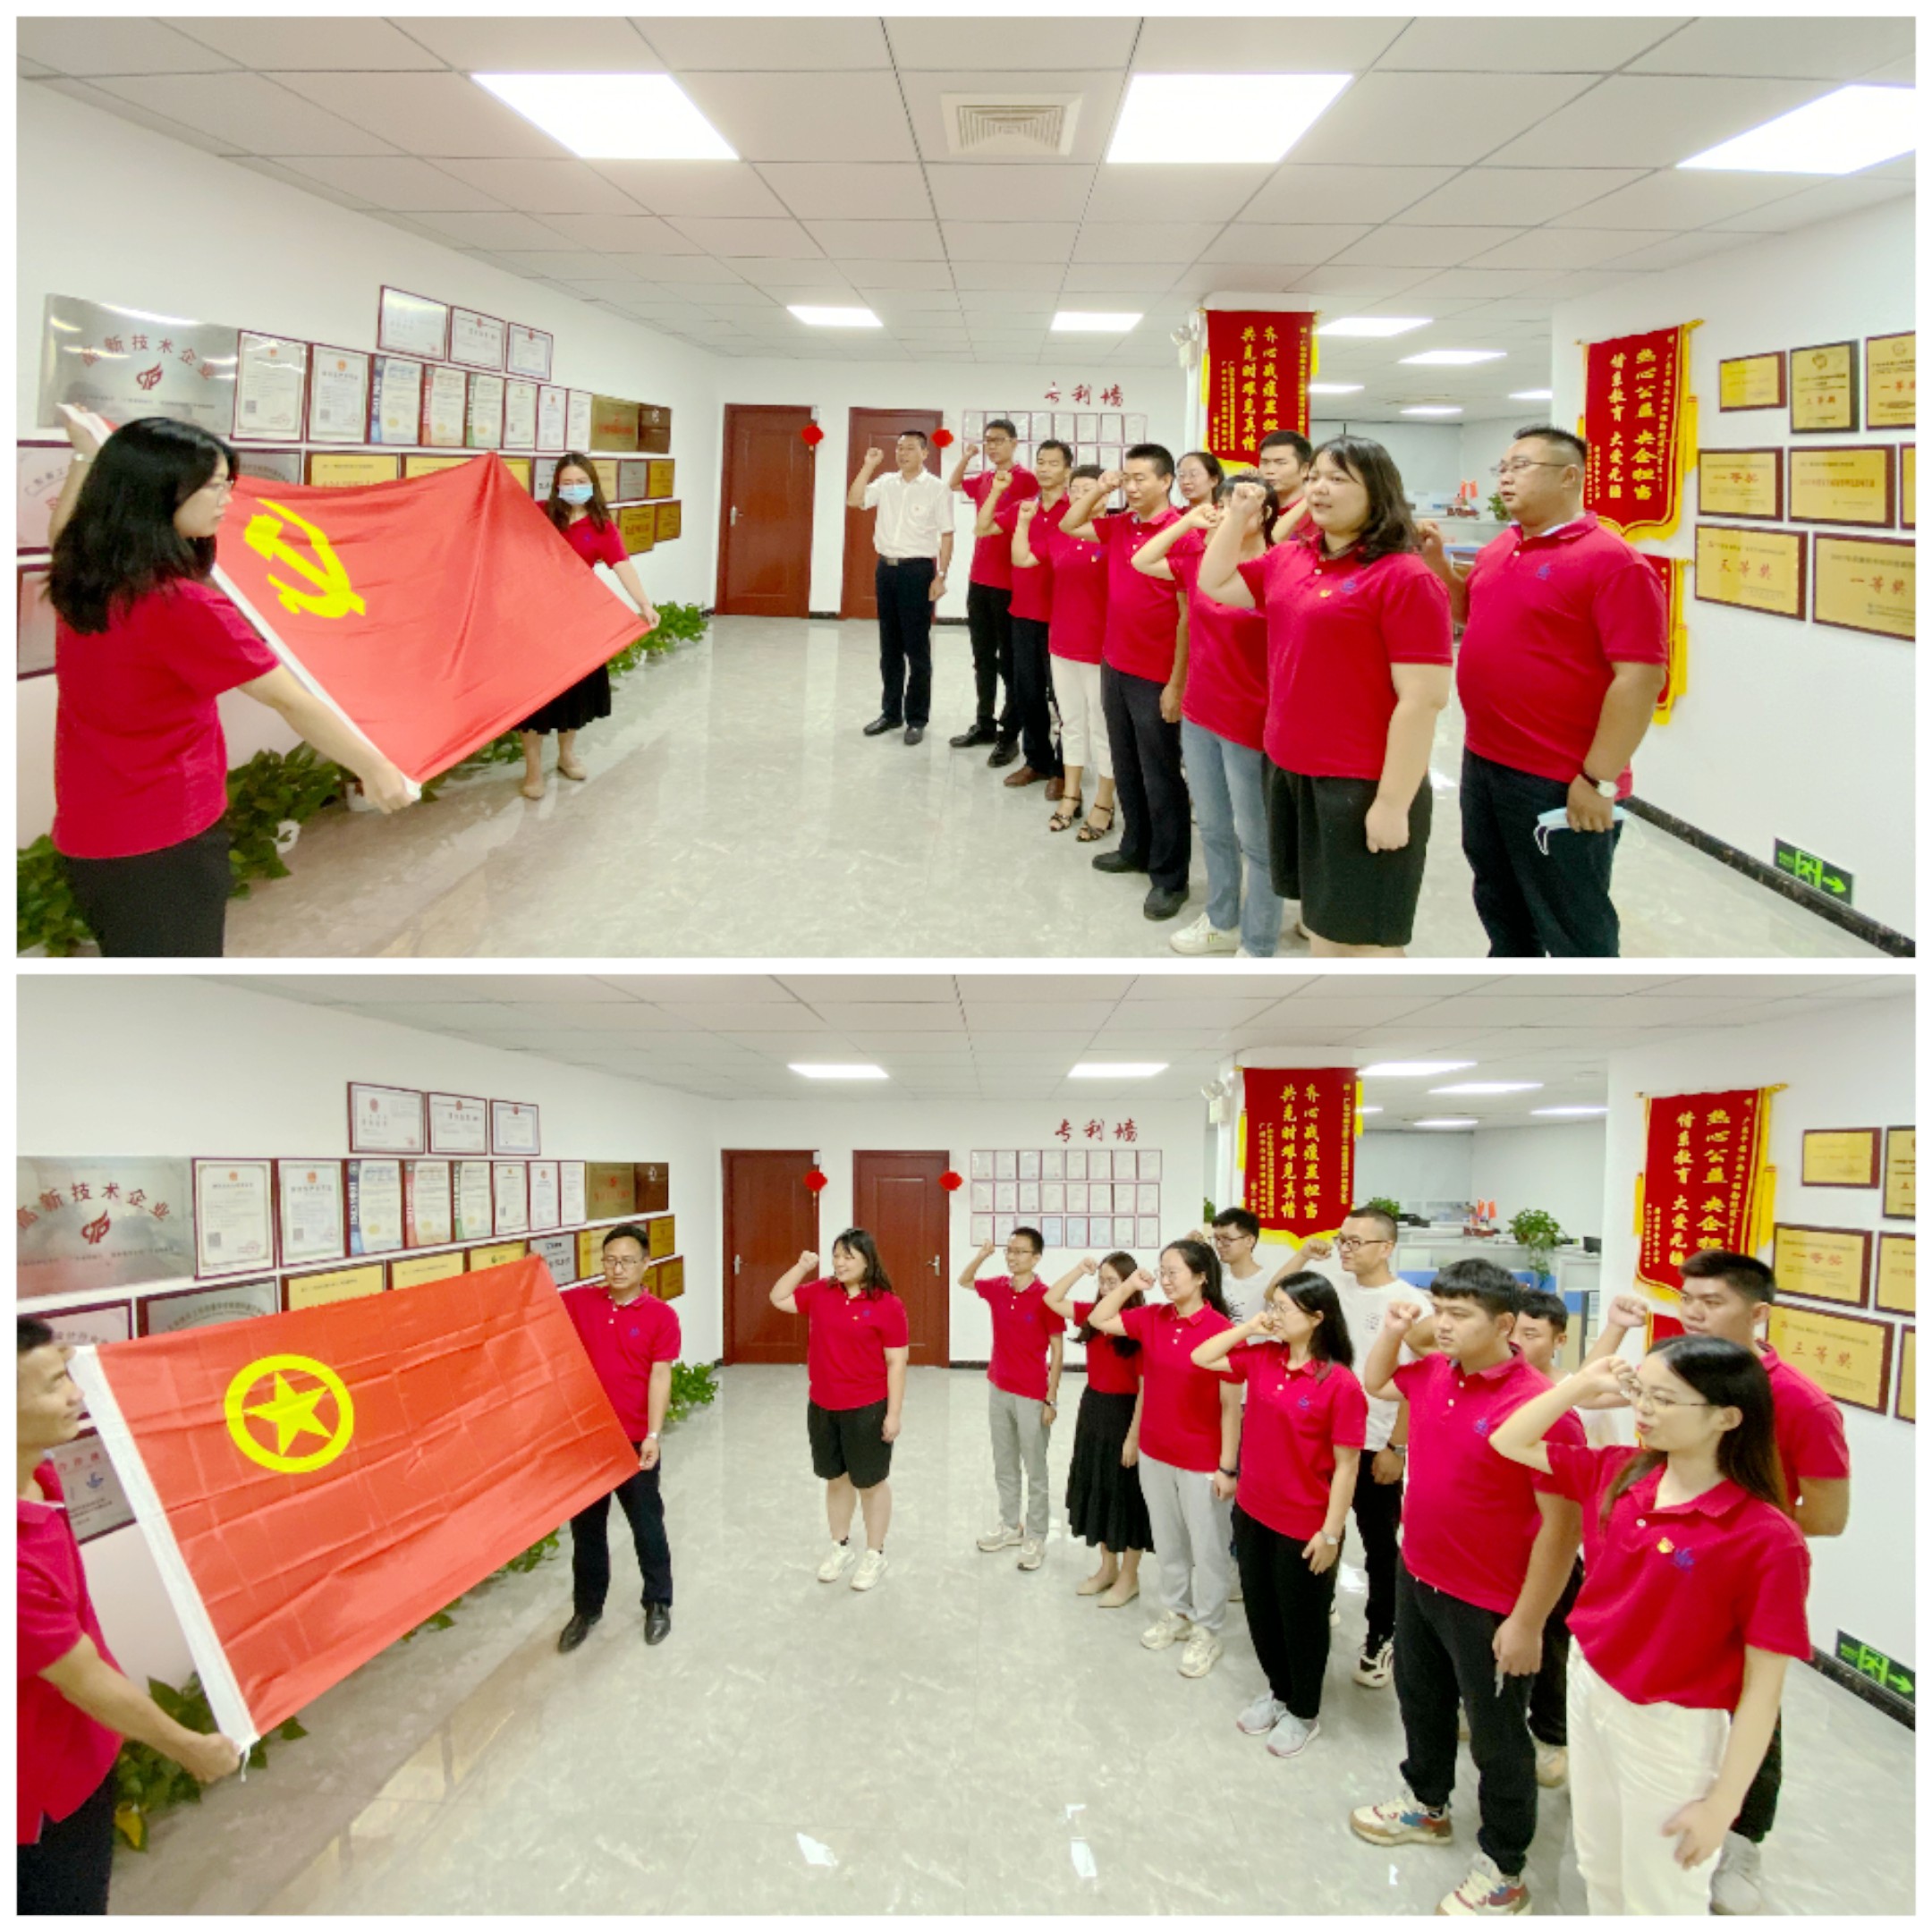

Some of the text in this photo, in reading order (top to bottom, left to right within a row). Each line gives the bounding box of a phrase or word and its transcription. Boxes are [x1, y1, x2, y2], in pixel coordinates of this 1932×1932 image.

[1044, 381, 1123, 408] 专利墙
[1054, 1117, 1137, 1143] 专利墙
[1696, 1195, 1727, 1249] 央企担
[1791, 1342, 1852, 1369] 三等奖
